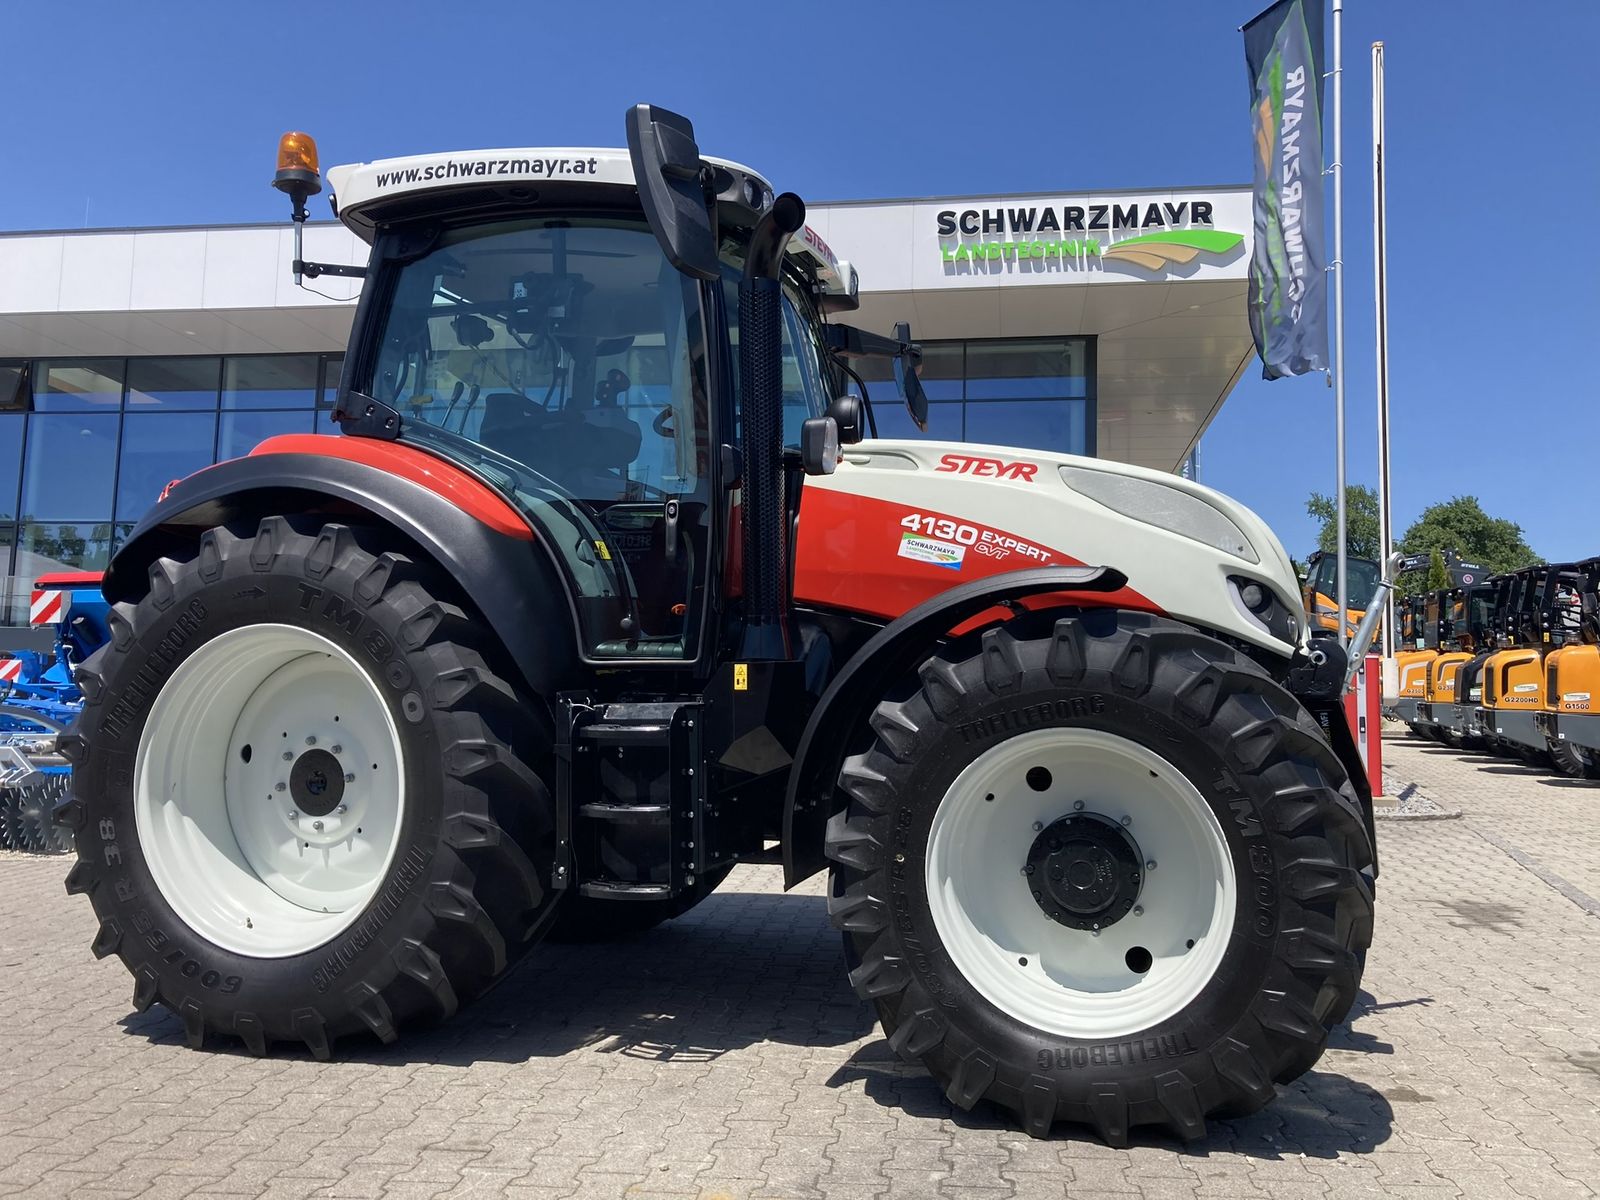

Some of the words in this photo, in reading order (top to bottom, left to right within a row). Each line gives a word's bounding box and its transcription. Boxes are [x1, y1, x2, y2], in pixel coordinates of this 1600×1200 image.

[376, 156, 597, 188] www.schwarzmayr.at
[936, 201, 1213, 236] SCHWARZMAYR
[942, 239, 1103, 261] LANDTECHNIK
[934, 454, 1038, 483] STEYR
[901, 513, 979, 546] 4130
[981, 531, 1051, 562] EXPERT
[906, 539, 956, 555] SCHWARZMAYR
[99, 598, 209, 740] TRELLEBORG
[956, 694, 1106, 744] TRELLEBORG
[130, 909, 243, 996] 600/65
[1036, 1032, 1199, 1072] TRELLEBORG
